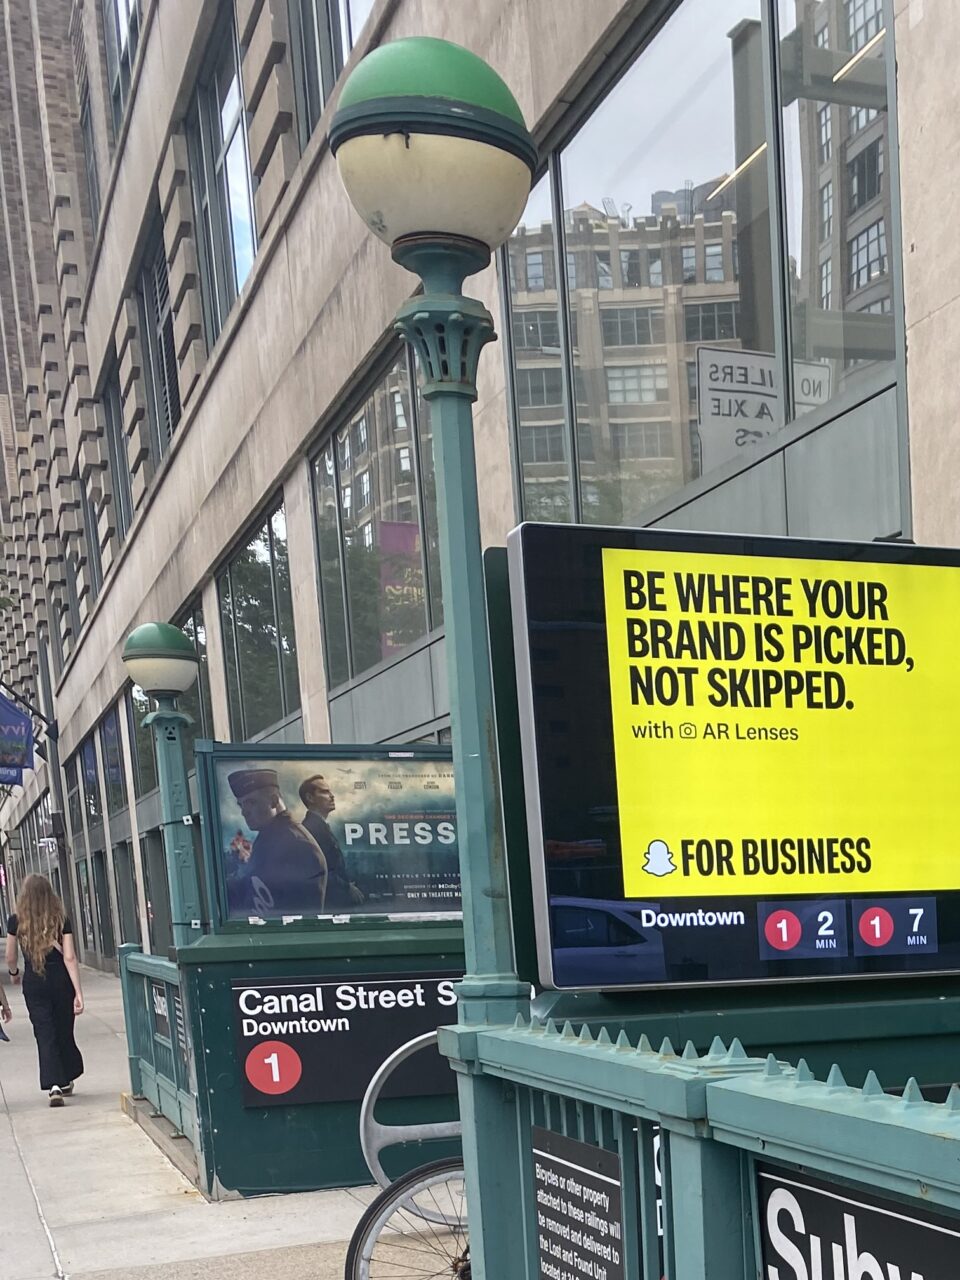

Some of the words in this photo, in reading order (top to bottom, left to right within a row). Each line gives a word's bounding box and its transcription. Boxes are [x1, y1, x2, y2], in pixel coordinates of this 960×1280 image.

[623, 570, 667, 611] BE
[674, 572, 793, 616] WHERE
[800, 578, 889, 621] YOUR
[626, 617, 746, 660] BRAND
[754, 622, 785, 663] IS
[792, 624, 915, 673] PICKED,
[629, 665, 699, 706] NOT
[707, 667, 855, 710] SKIPPED.
[632, 721, 674, 739] with
[703, 723, 730, 740] AR
[736, 723, 799, 741] Lenses
[344, 822, 456, 845] PRESS
[681, 839, 736, 876] FOR
[742, 837, 872, 876] BUSINESS
[641, 908, 745, 928] Downtown
[776, 918, 788, 942] 1
[817, 911, 835, 936] 2
[868, 915, 881, 939] 1
[908, 908, 925, 932] 7
[816, 939, 837, 950] MIN
[907, 935, 928, 945] MIN
[238, 987, 324, 1016] Canal
[335, 984, 426, 1011] Street
[242, 1016, 350, 1037] Downtown
[264, 1053, 280, 1083] 1
[535, 1162, 559, 1187] Bicycles
[559, 1176, 566, 1190] or
[566, 1177, 582, 1197] other
[582, 1186, 610, 1213] property
[537, 1189, 561, 1211] attached
[560, 1198, 568, 1215] to
[567, 1200, 585, 1223] these
[584, 1210, 609, 1237] railings
[608, 1221, 621, 1240] will
[538, 1210, 546, 1228] be
[546, 1217, 570, 1240] removed
[570, 1229, 582, 1247] and
[582, 1232, 612, 1261] delivered
[612, 1246, 620, 1265] to
[539, 1234, 549, 1252] the
[548, 1238, 562, 1260] Lost
[562, 1249, 574, 1266] and
[573, 1251, 593, 1277] Found
